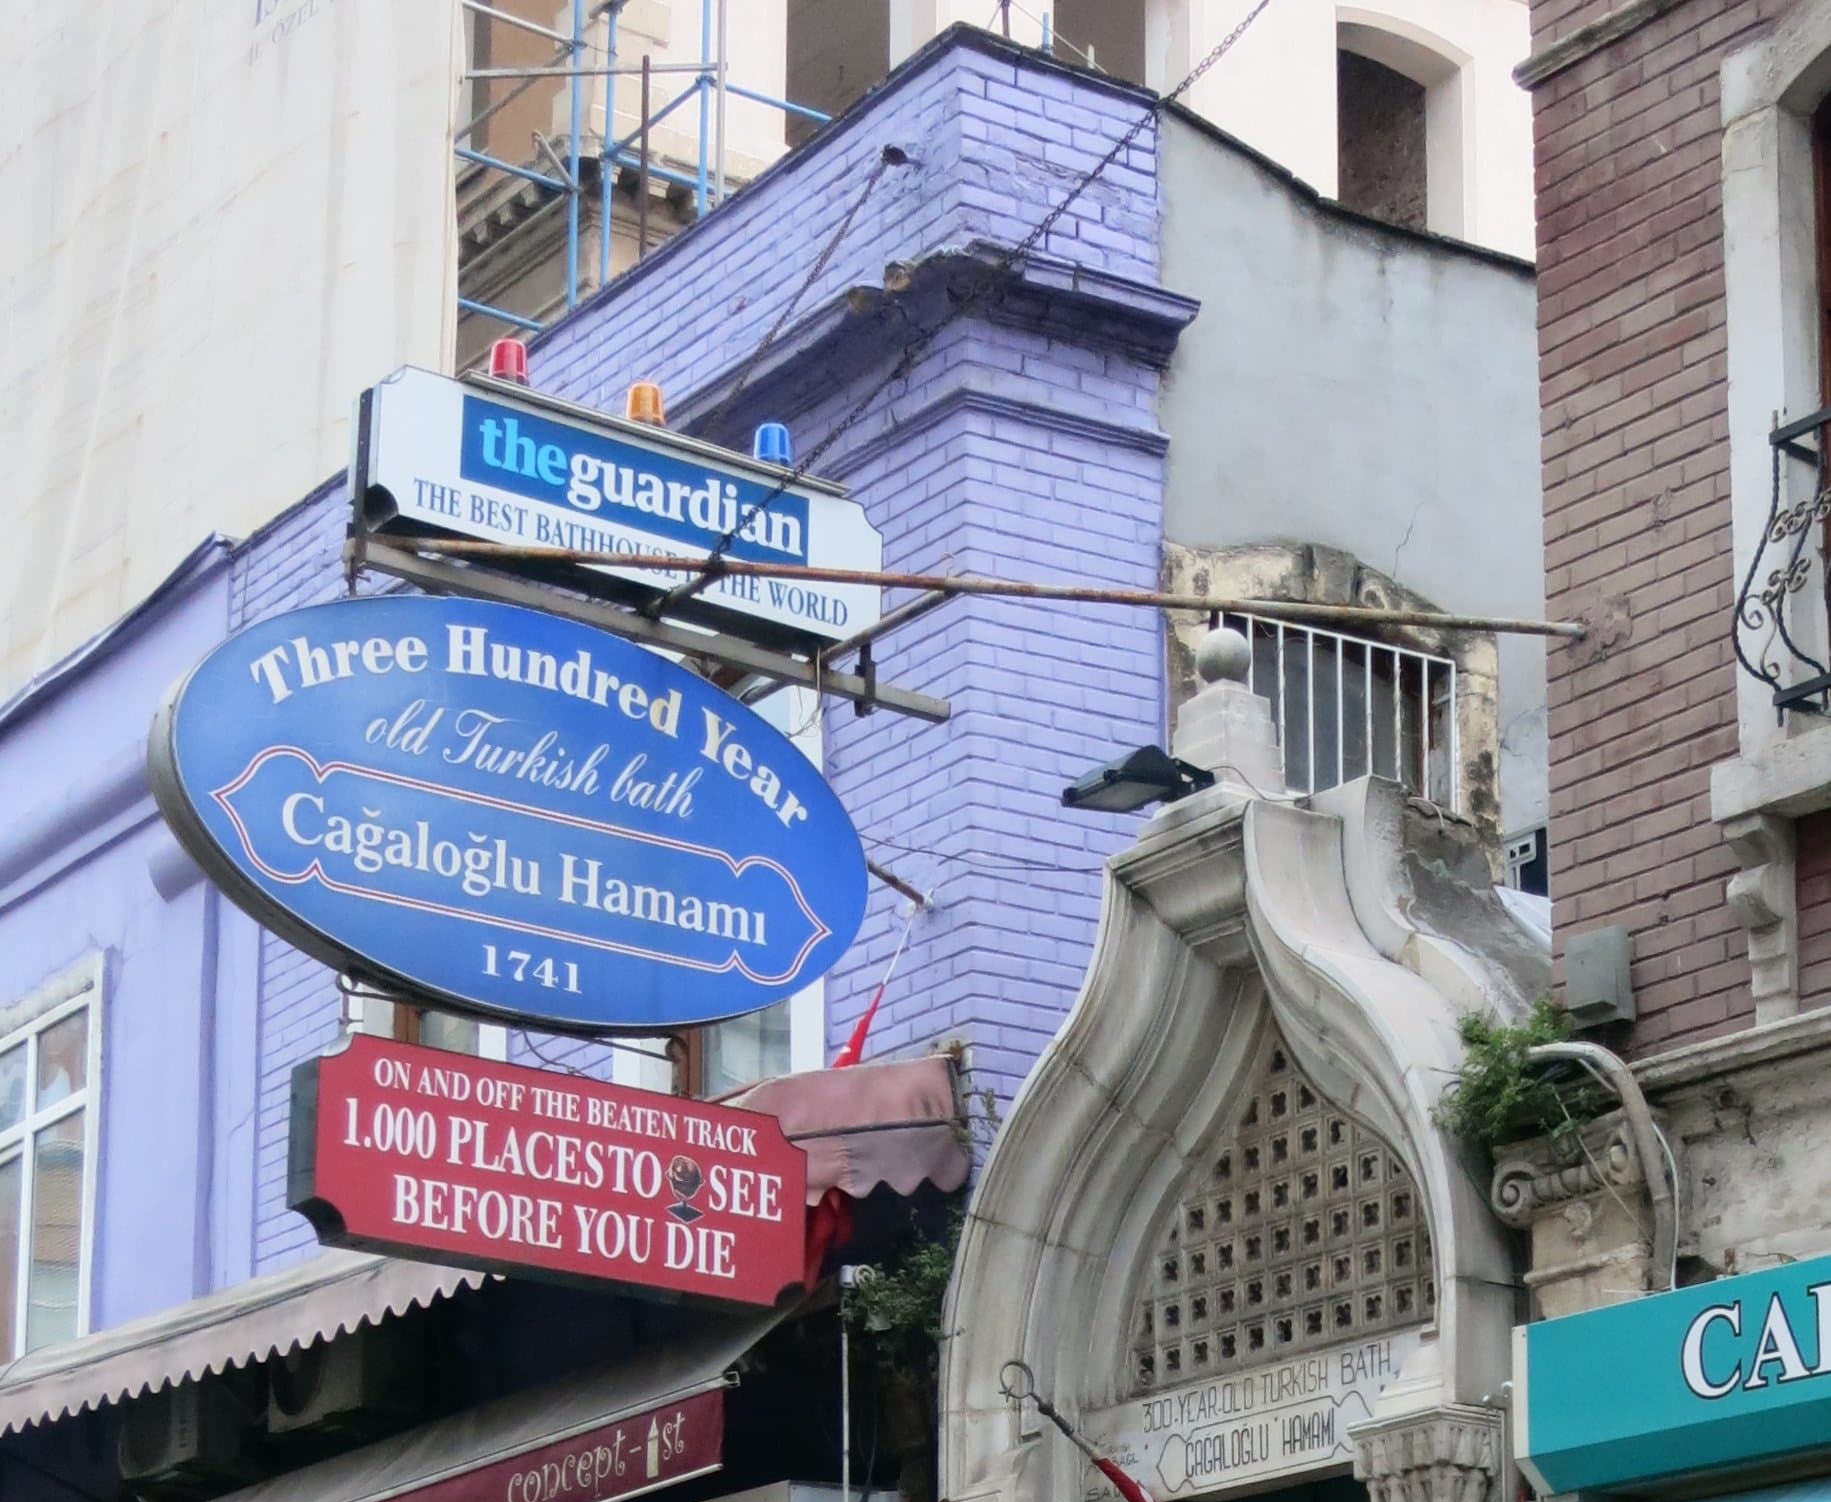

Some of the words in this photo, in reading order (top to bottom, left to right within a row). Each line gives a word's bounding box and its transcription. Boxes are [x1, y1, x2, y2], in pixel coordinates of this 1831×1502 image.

[414, 477, 461, 525] THE
[470, 491, 528, 537] BEST
[719, 568, 761, 603] THE
[767, 578, 849, 627] WORLD
[250, 635, 429, 704] Three
[446, 623, 682, 738] Hundred
[700, 706, 808, 829] Year
[365, 698, 445, 756] old
[442, 709, 610, 796] Turkish
[610, 752, 704, 818] bath
[281, 792, 541, 897] Cağaloğlu
[559, 854, 767, 946] Hamamı
[481, 943, 583, 995] 1741
[343, 1096, 436, 1160] 1.000
[446, 1115, 603, 1190] PLACES
[608, 1144, 662, 1199] TO
[708, 1163, 782, 1222] SEE
[373, 1057, 411, 1090] ON
[416, 1066, 471, 1101] AND
[476, 1078, 524, 1112] OFF
[530, 1087, 580, 1122] THE
[587, 1096, 677, 1140] BEATEN
[684, 1115, 758, 1157] TRACK
[392, 1174, 563, 1250] BEFORE
[573, 1204, 652, 1265] YOU
[663, 1221, 737, 1279] DIE
[1261, 1357, 1328, 1404] TURKISH
[1340, 1341, 1391, 1385] BATH
[1282, 1407, 1335, 1456] HAMAMI
